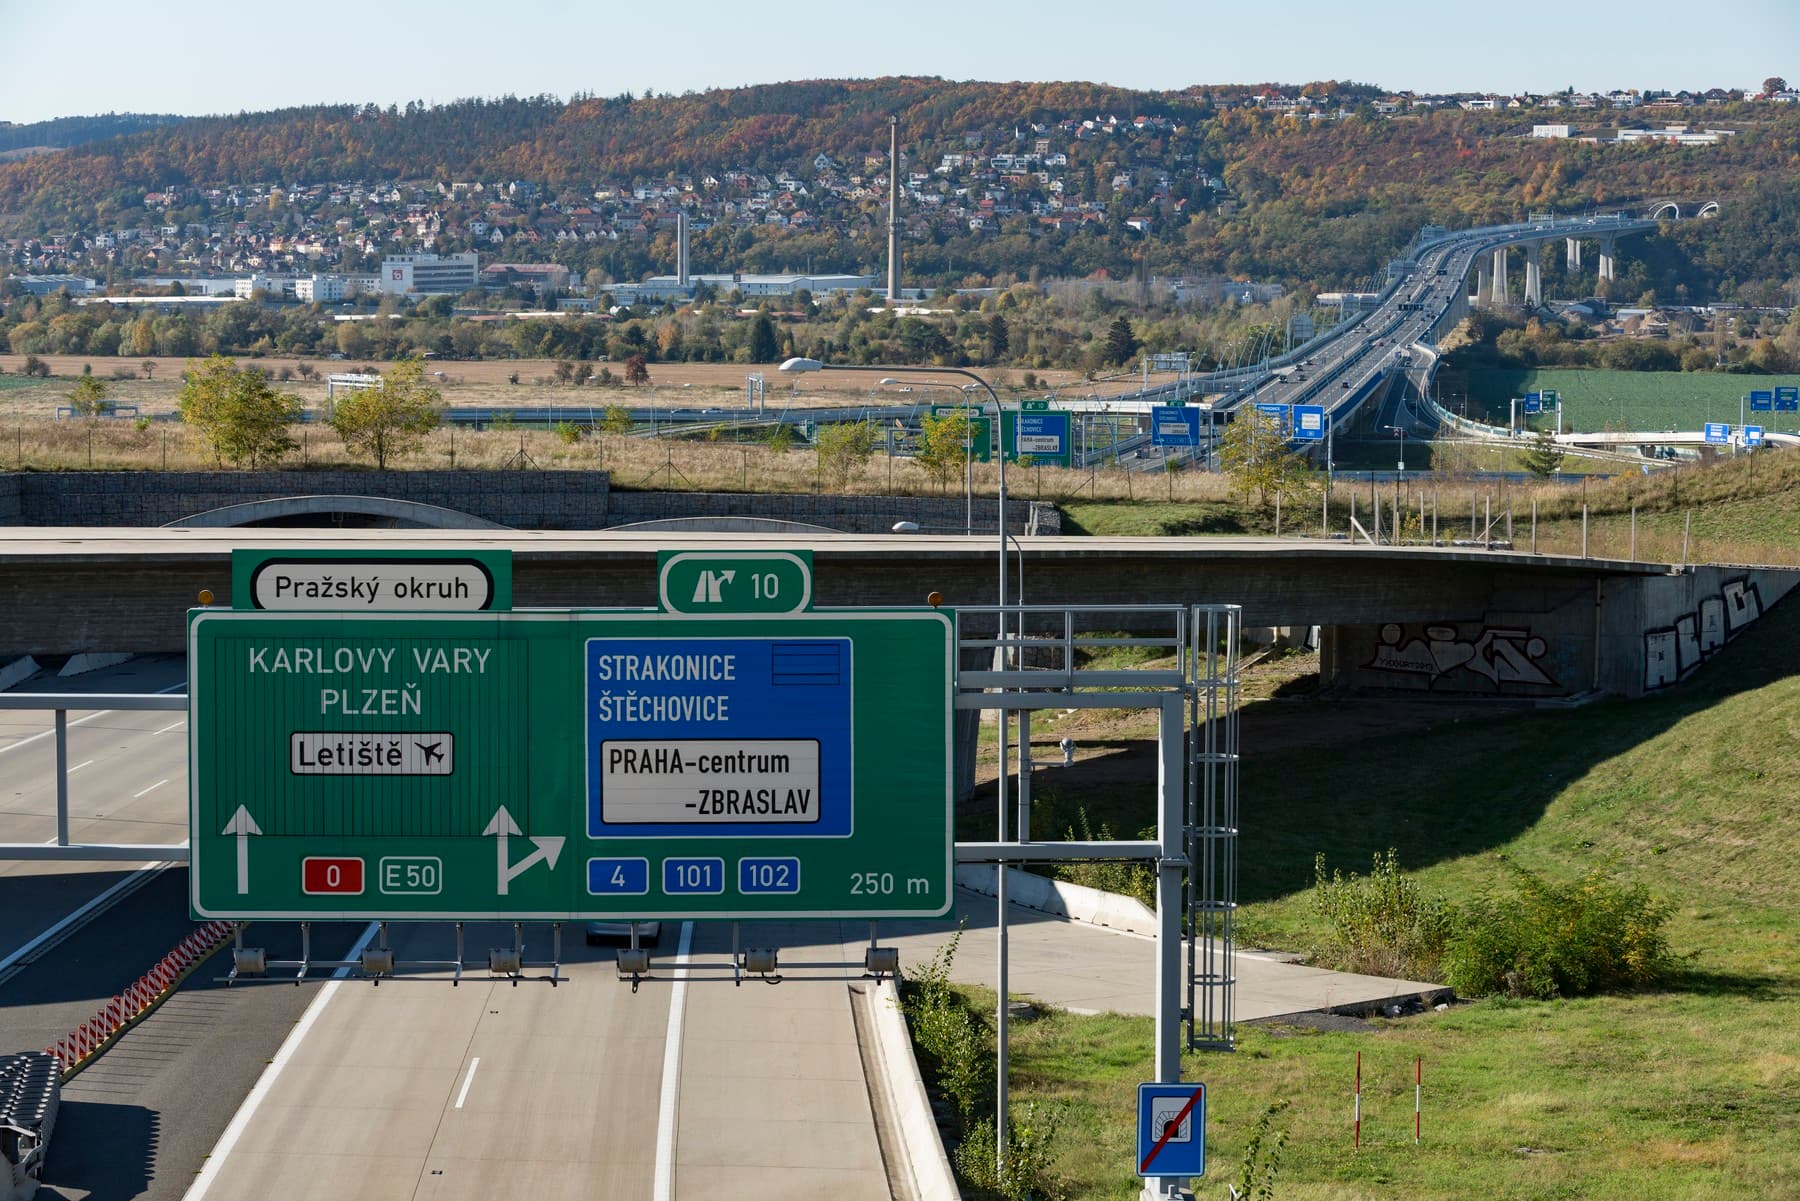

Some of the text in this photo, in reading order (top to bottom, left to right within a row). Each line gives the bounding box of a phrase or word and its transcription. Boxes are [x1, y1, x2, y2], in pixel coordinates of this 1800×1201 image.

[275, 575, 469, 603] Pražský okruh
[751, 573, 780, 599] 10
[248, 647, 492, 674] KARLOVY VARY
[598, 654, 737, 681] STRAKONICE
[321, 682, 422, 715] PLZEŇ
[598, 689, 730, 722] ŠTĚCHOVICE
[299, 741, 403, 767] Letiště
[609, 748, 790, 774] PRAHA-centrum
[685, 788, 811, 816] -ZBRASLAV
[326, 864, 341, 888] 0
[610, 865, 626, 887] 4
[676, 865, 712, 887] 101
[749, 865, 790, 887] 102
[850, 873, 930, 895] 250 m
